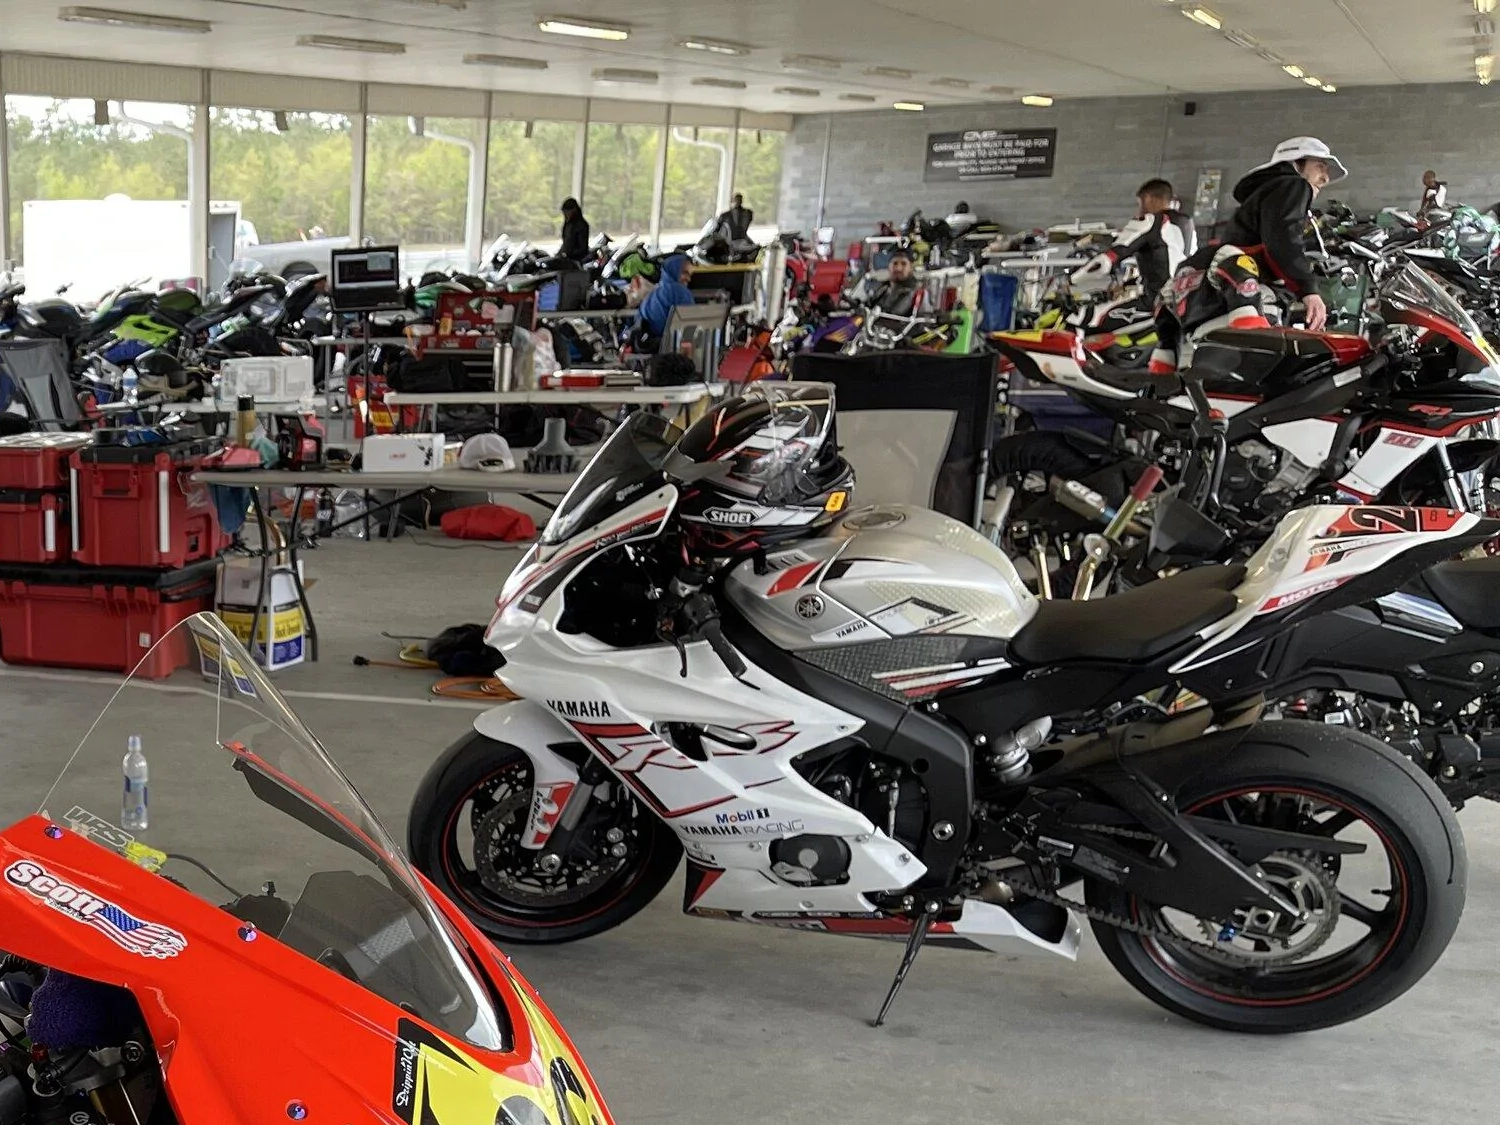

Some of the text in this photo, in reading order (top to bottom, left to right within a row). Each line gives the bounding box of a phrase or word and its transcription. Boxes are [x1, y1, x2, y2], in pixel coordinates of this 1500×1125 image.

[710, 510, 752, 525] SHOEI
[835, 621, 870, 640] YAMAHA
[546, 700, 612, 718] YAMAHA
[715, 810, 755, 824] Mobil
[681, 819, 805, 836] YAMAHA RACING
[7, 862, 110, 917] Scott
